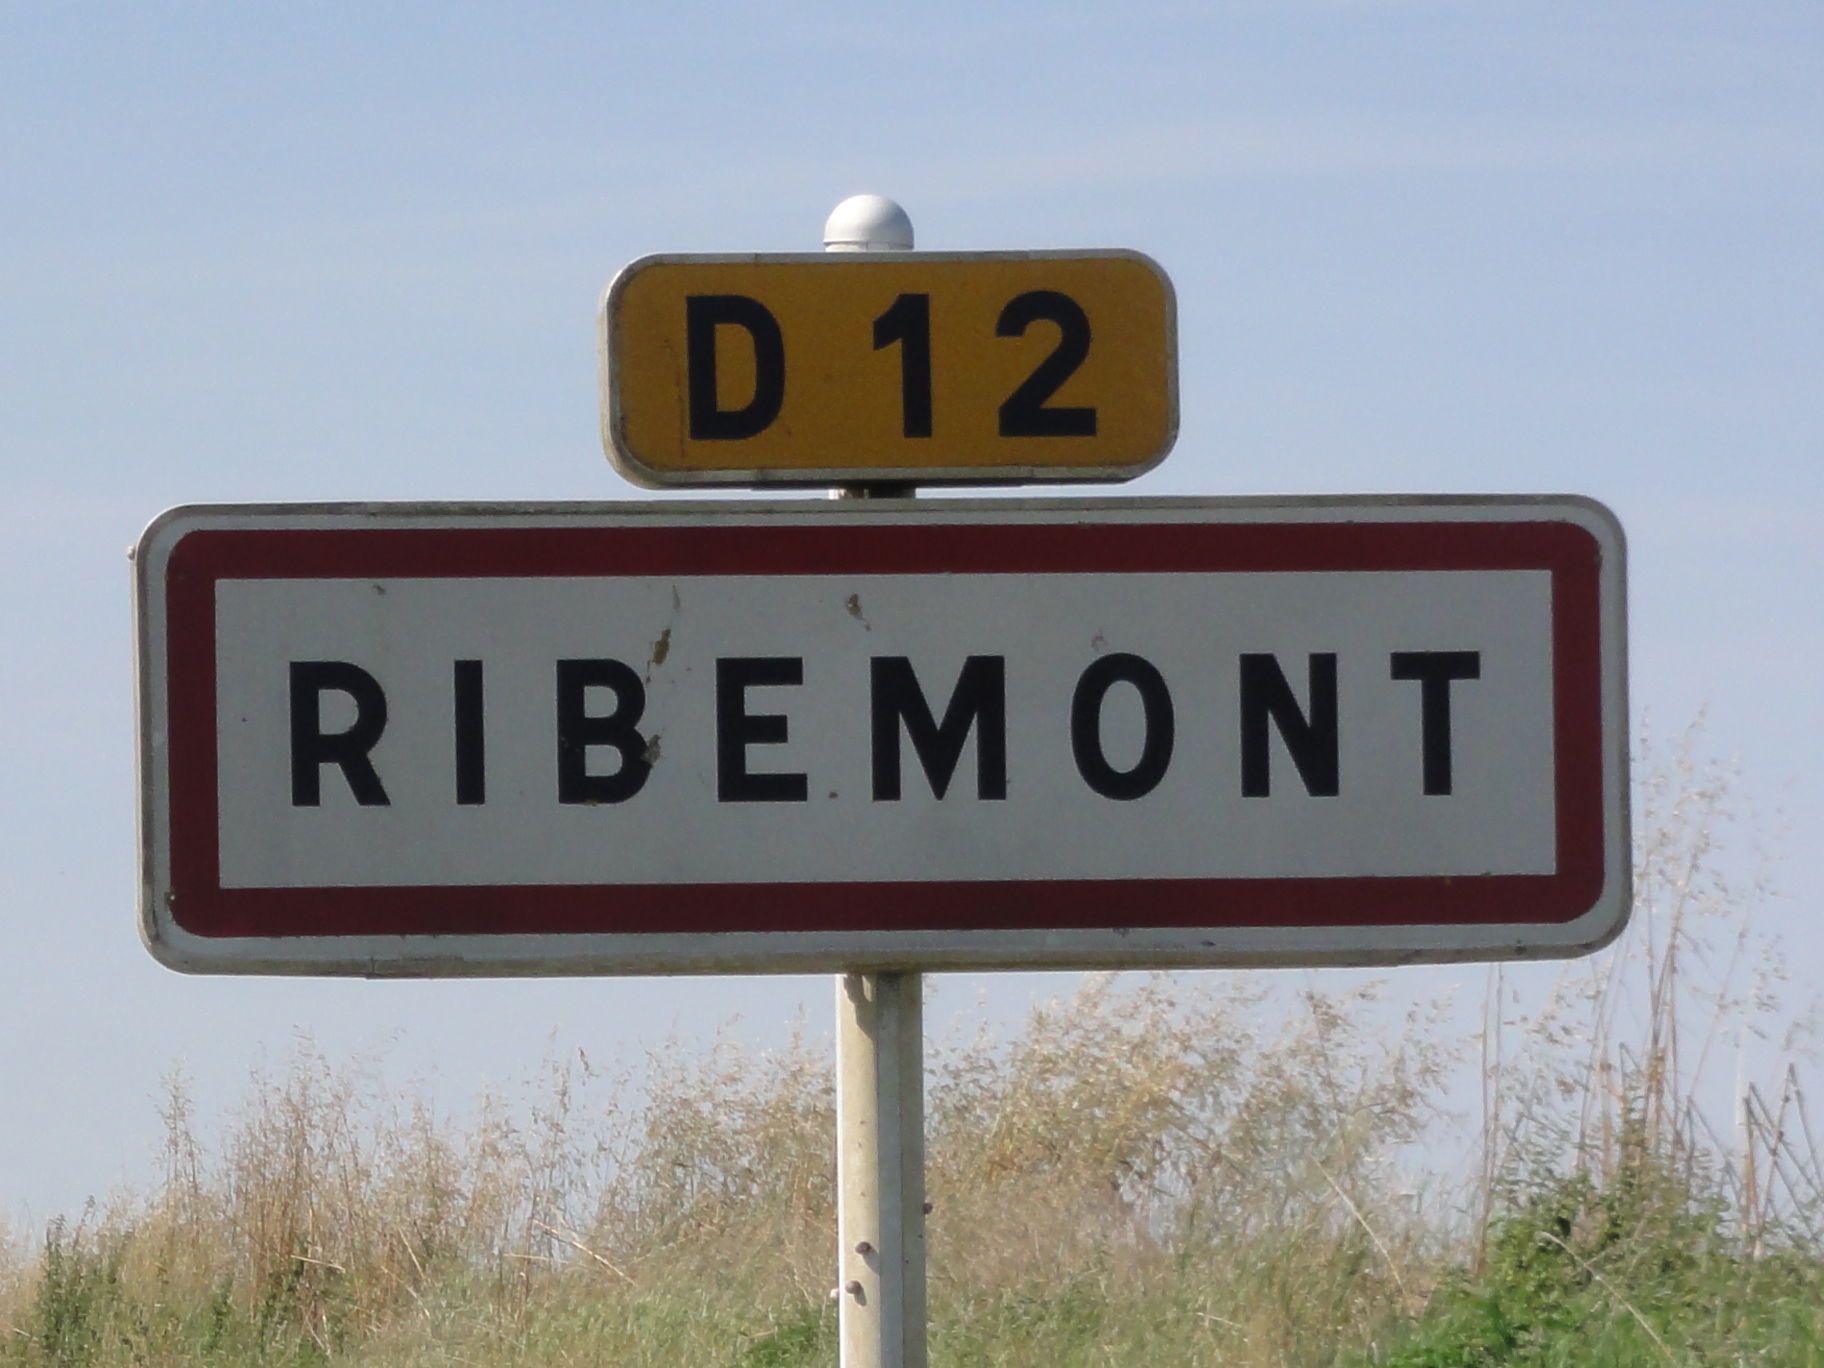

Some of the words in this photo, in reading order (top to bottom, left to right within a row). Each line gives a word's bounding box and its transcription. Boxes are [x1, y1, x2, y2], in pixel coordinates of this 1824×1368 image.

[685, 294, 785, 441] D
[871, 290, 1098, 438] 12
[287, 650, 1482, 809] RIBEMONT
